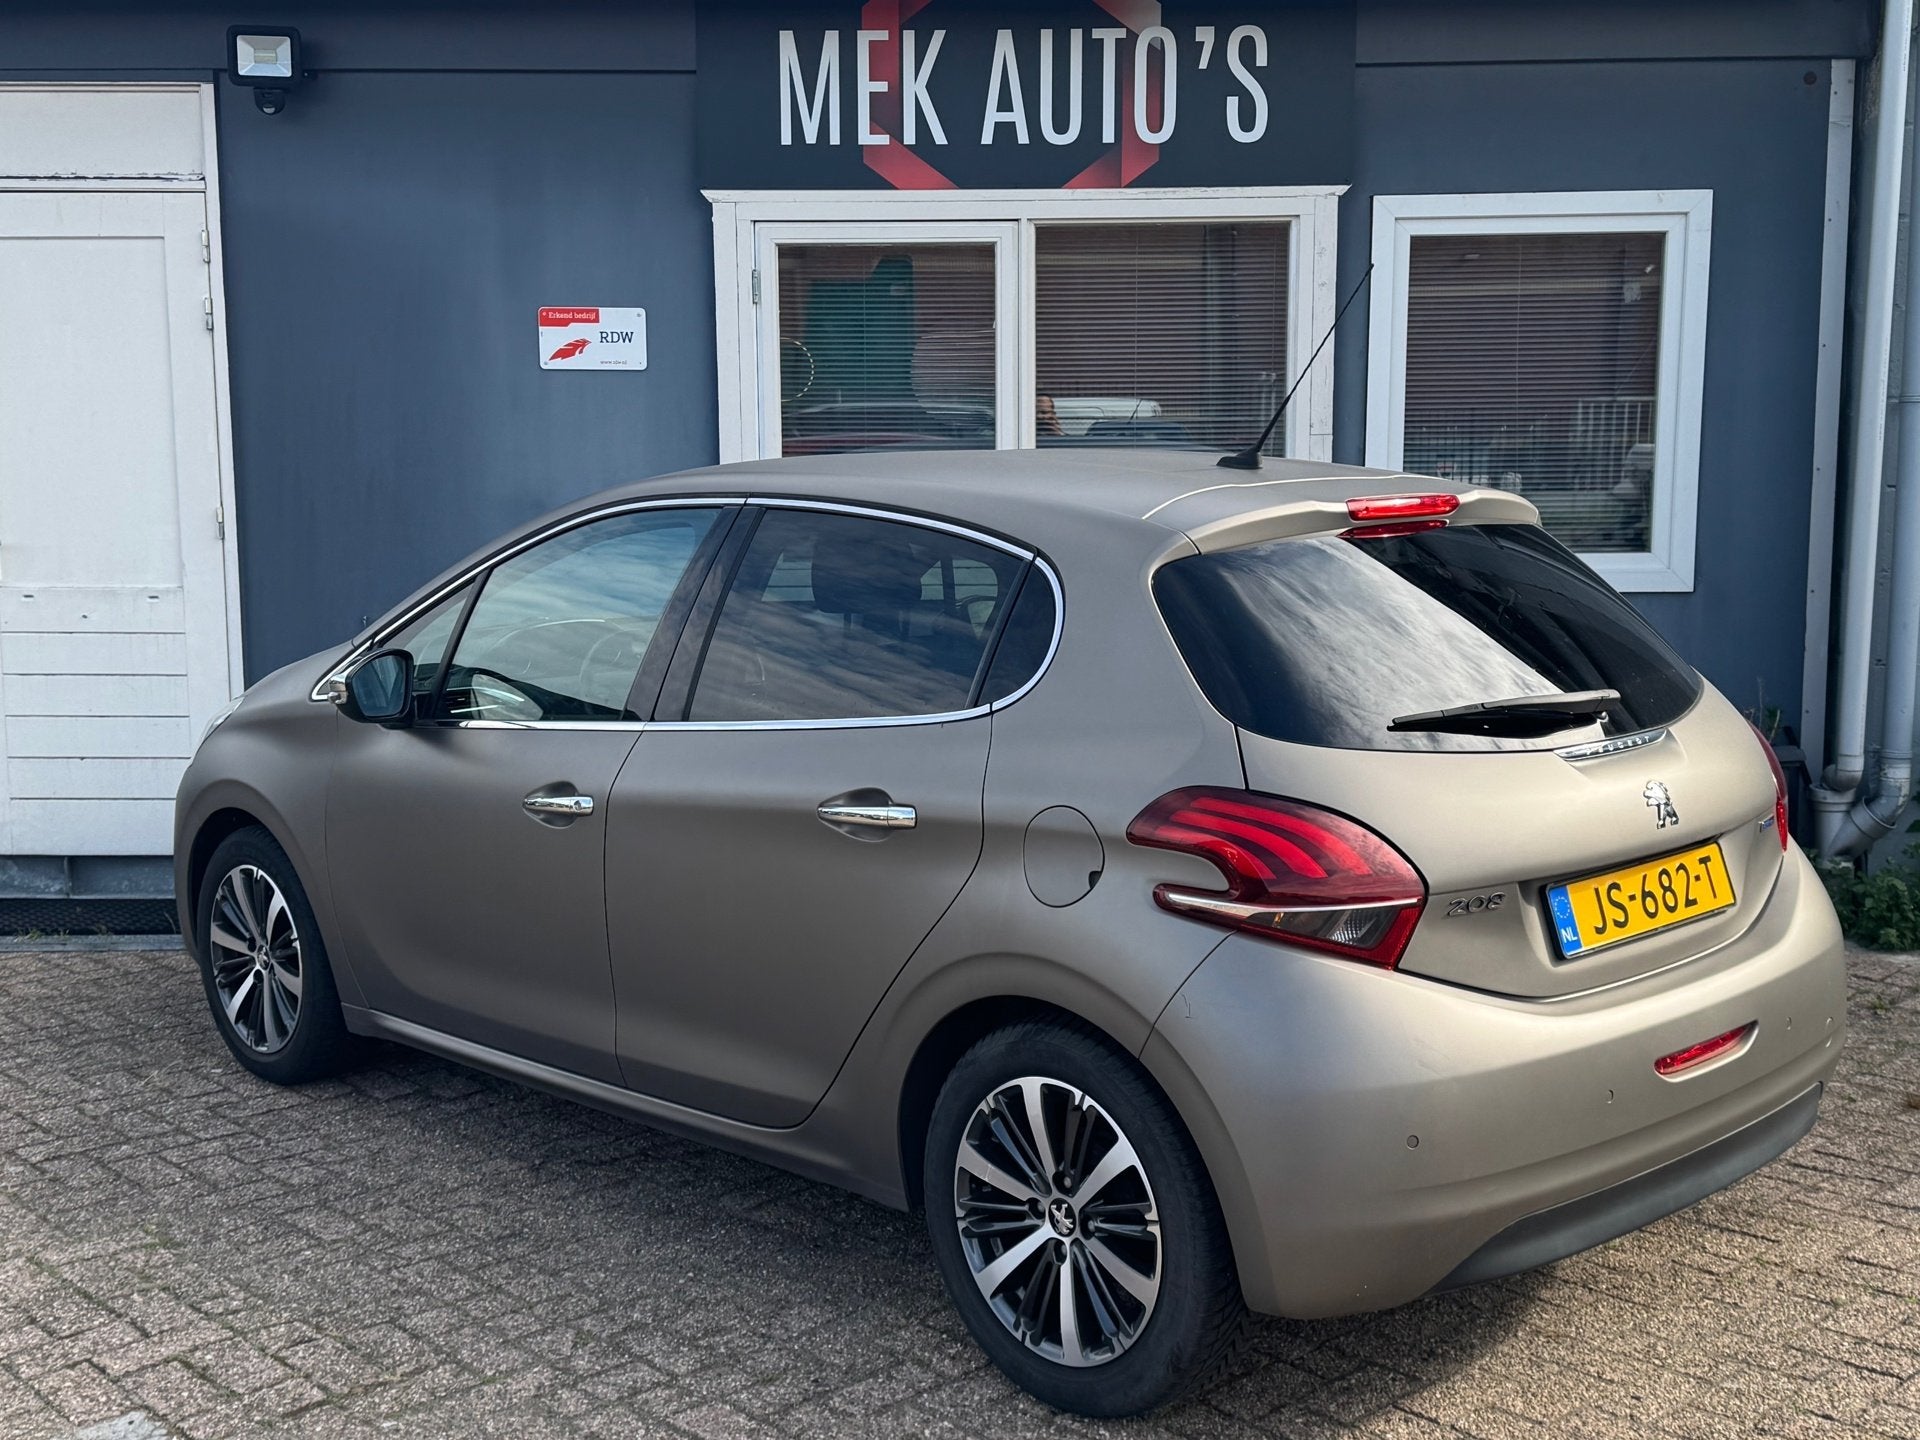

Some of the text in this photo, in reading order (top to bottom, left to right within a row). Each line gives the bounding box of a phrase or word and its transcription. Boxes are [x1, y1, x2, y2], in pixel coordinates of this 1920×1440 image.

[779, 25, 1269, 145] MEK AUTO'S
[548, 311, 596, 321] Erkend bedrijf
[599, 331, 634, 344] RDW
[1594, 854, 1718, 935] JS-682-T
[1561, 926, 1578, 944] NL
